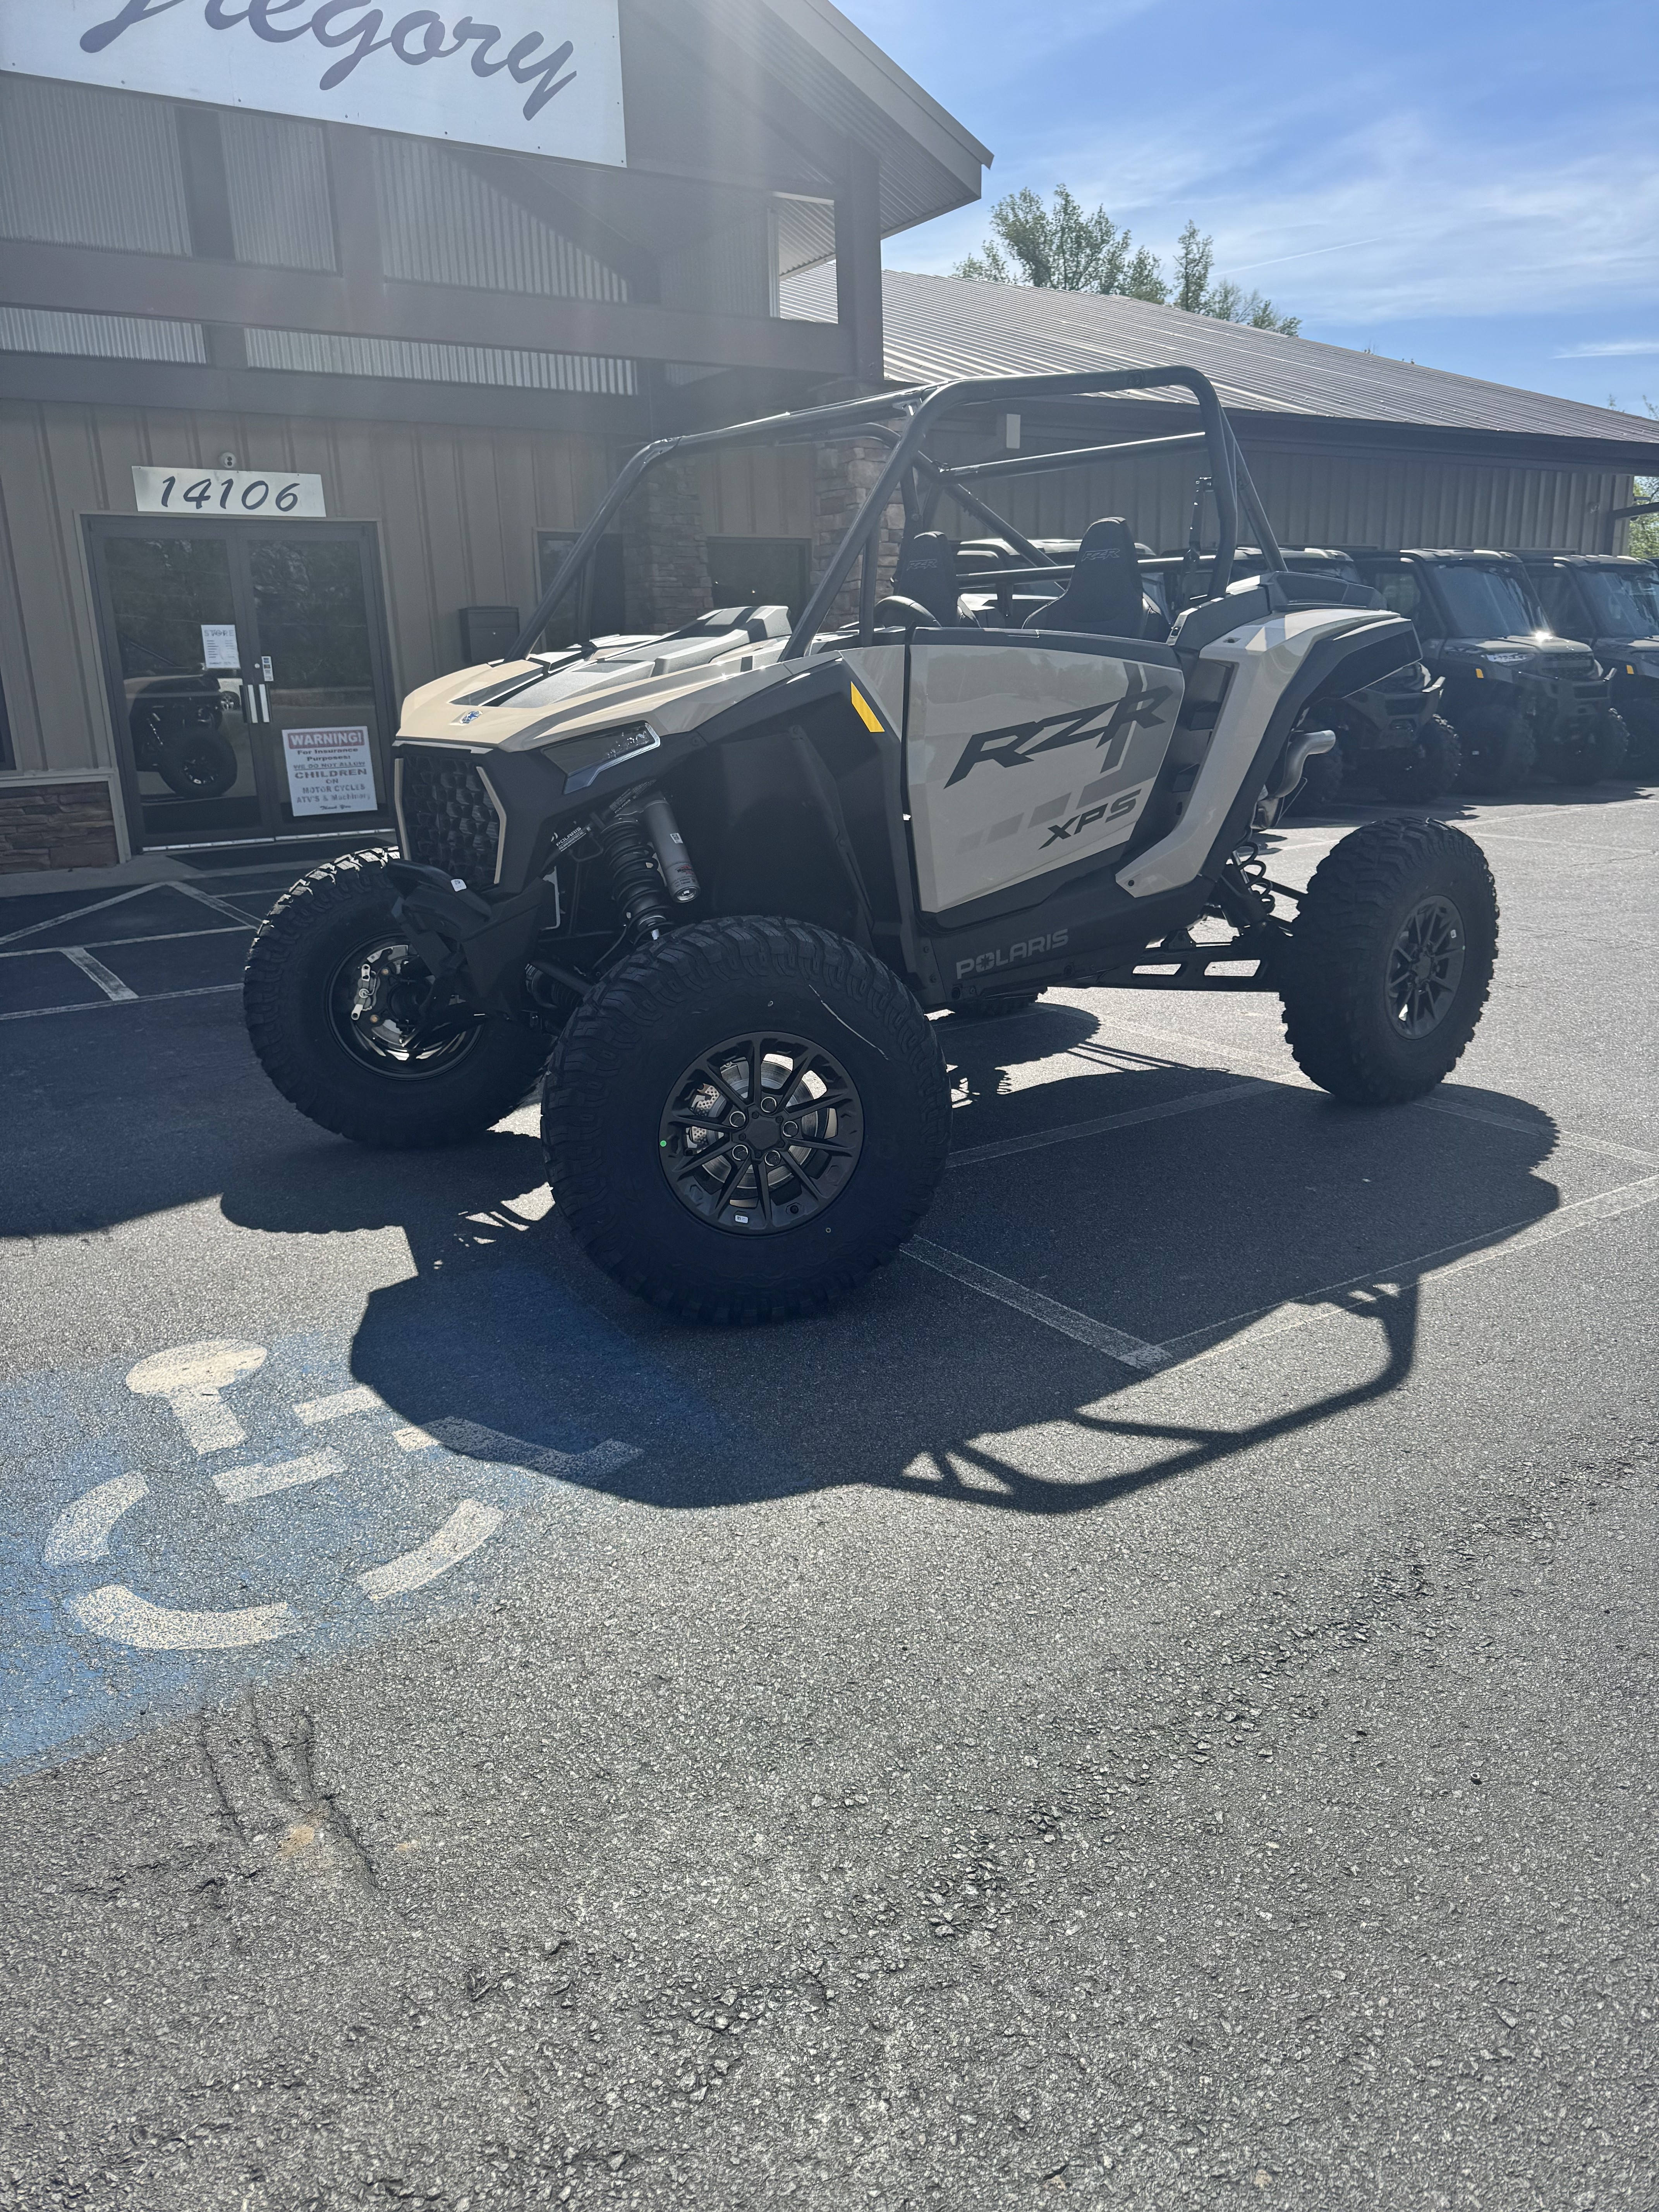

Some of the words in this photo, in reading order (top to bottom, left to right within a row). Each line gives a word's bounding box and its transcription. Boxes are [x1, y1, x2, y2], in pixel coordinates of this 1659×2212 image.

[161, 476, 300, 512] 14106
[1081, 548, 1120, 562] RZR
[906, 559, 938, 571] RZR
[291, 732, 362, 746] WARNING!
[943, 685, 1174, 790] RZR
[295, 769, 367, 779] CHILDREN
[334, 784, 365, 792] CYCLES
[1037, 788, 1142, 850] XPS
[556, 826, 582, 847] POLARIS
[956, 929, 1068, 979] POLARIS
